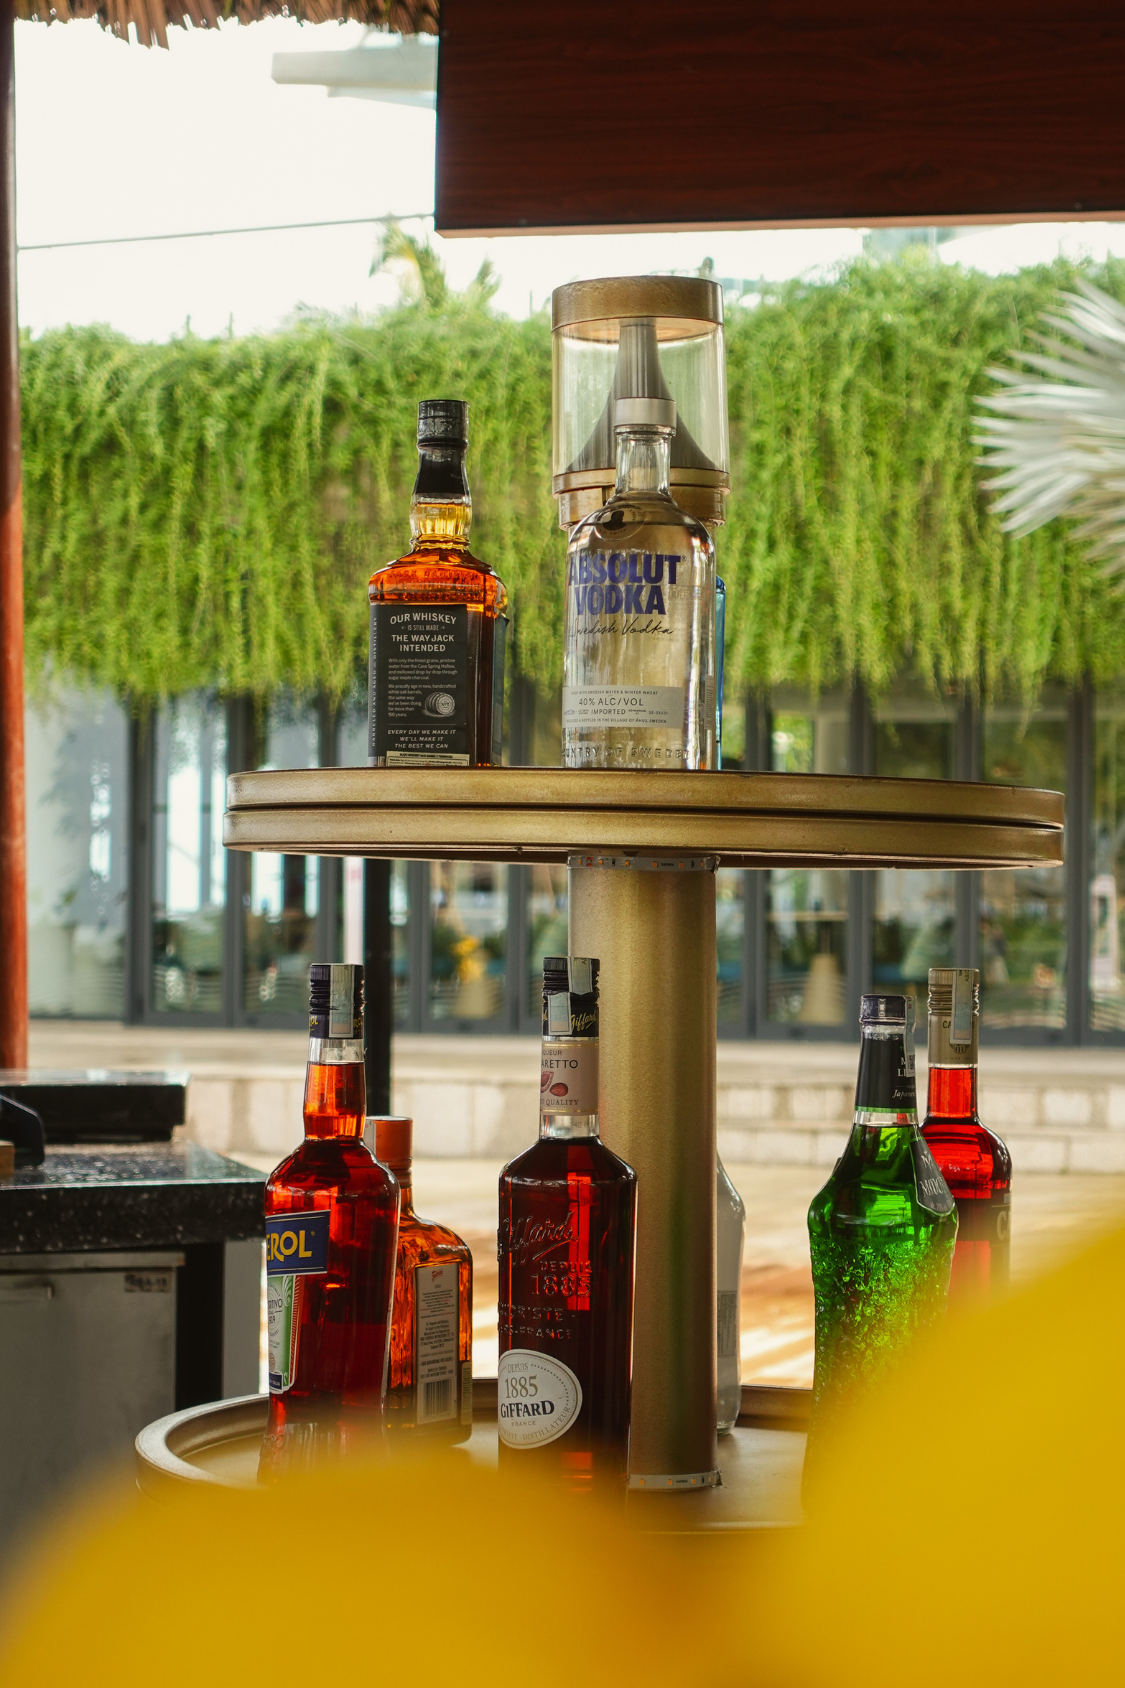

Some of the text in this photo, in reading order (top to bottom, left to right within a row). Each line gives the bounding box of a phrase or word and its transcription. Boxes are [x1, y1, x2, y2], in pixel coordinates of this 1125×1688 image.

[568, 553, 681, 586] ABSOLUT
[574, 584, 667, 616] VODKA
[390, 612, 457, 625] OUR WHISKEY
[621, 616, 674, 636] Vodka
[391, 634, 455, 642] THE WAY JACK
[399, 644, 446, 652] INTENDED
[579, 697, 644, 706] 40% ALC/VOL
[546, 1099, 580, 1107] QUALITY
[531, 1273, 592, 1298] 1885
[507, 1363, 529, 1373] DEPUIS
[505, 1374, 539, 1399] 1885
[500, 1400, 555, 1418] GIFFARD
[522, 1406, 571, 1440] DISTILLATEUR
